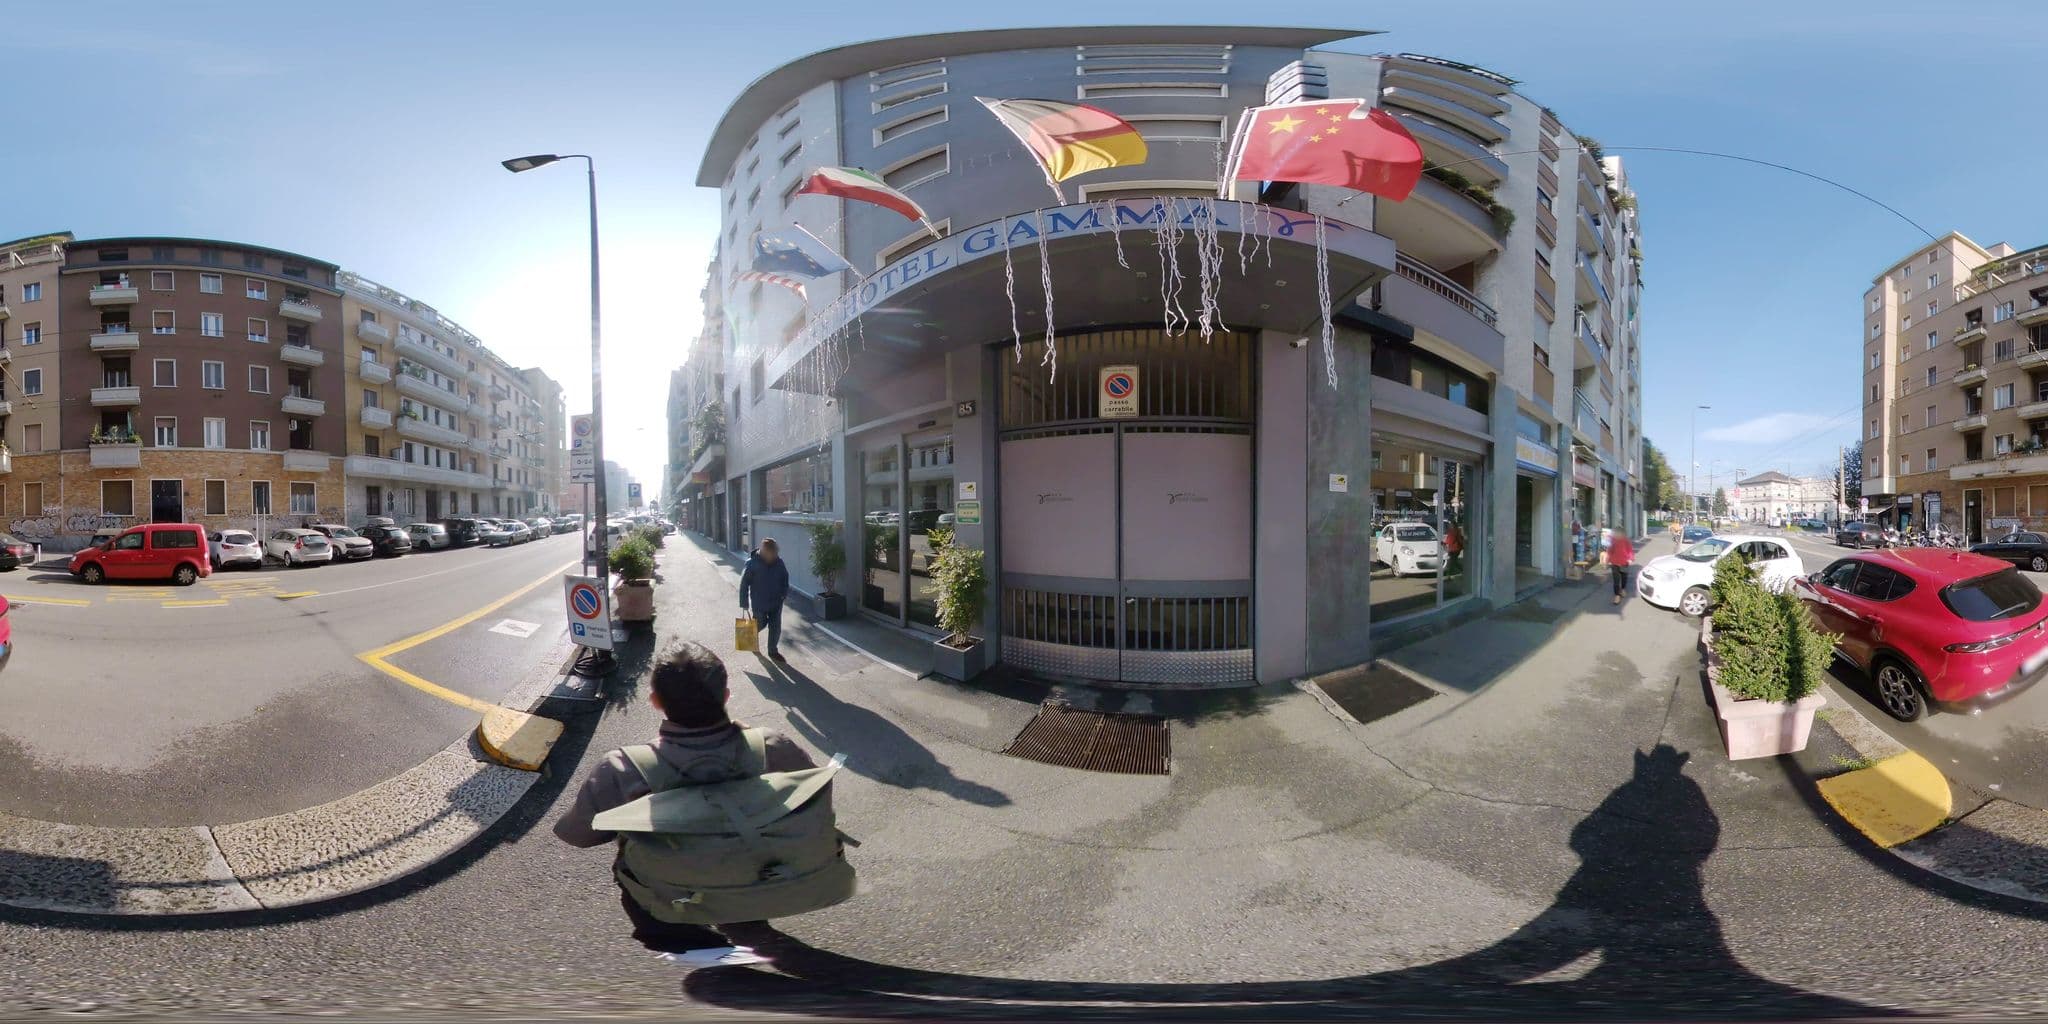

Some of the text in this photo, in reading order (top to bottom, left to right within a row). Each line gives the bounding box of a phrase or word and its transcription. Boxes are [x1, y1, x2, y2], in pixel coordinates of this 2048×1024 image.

[841, 201, 1229, 322] HOTEL GAMMA
[959, 403, 972, 416] 85
